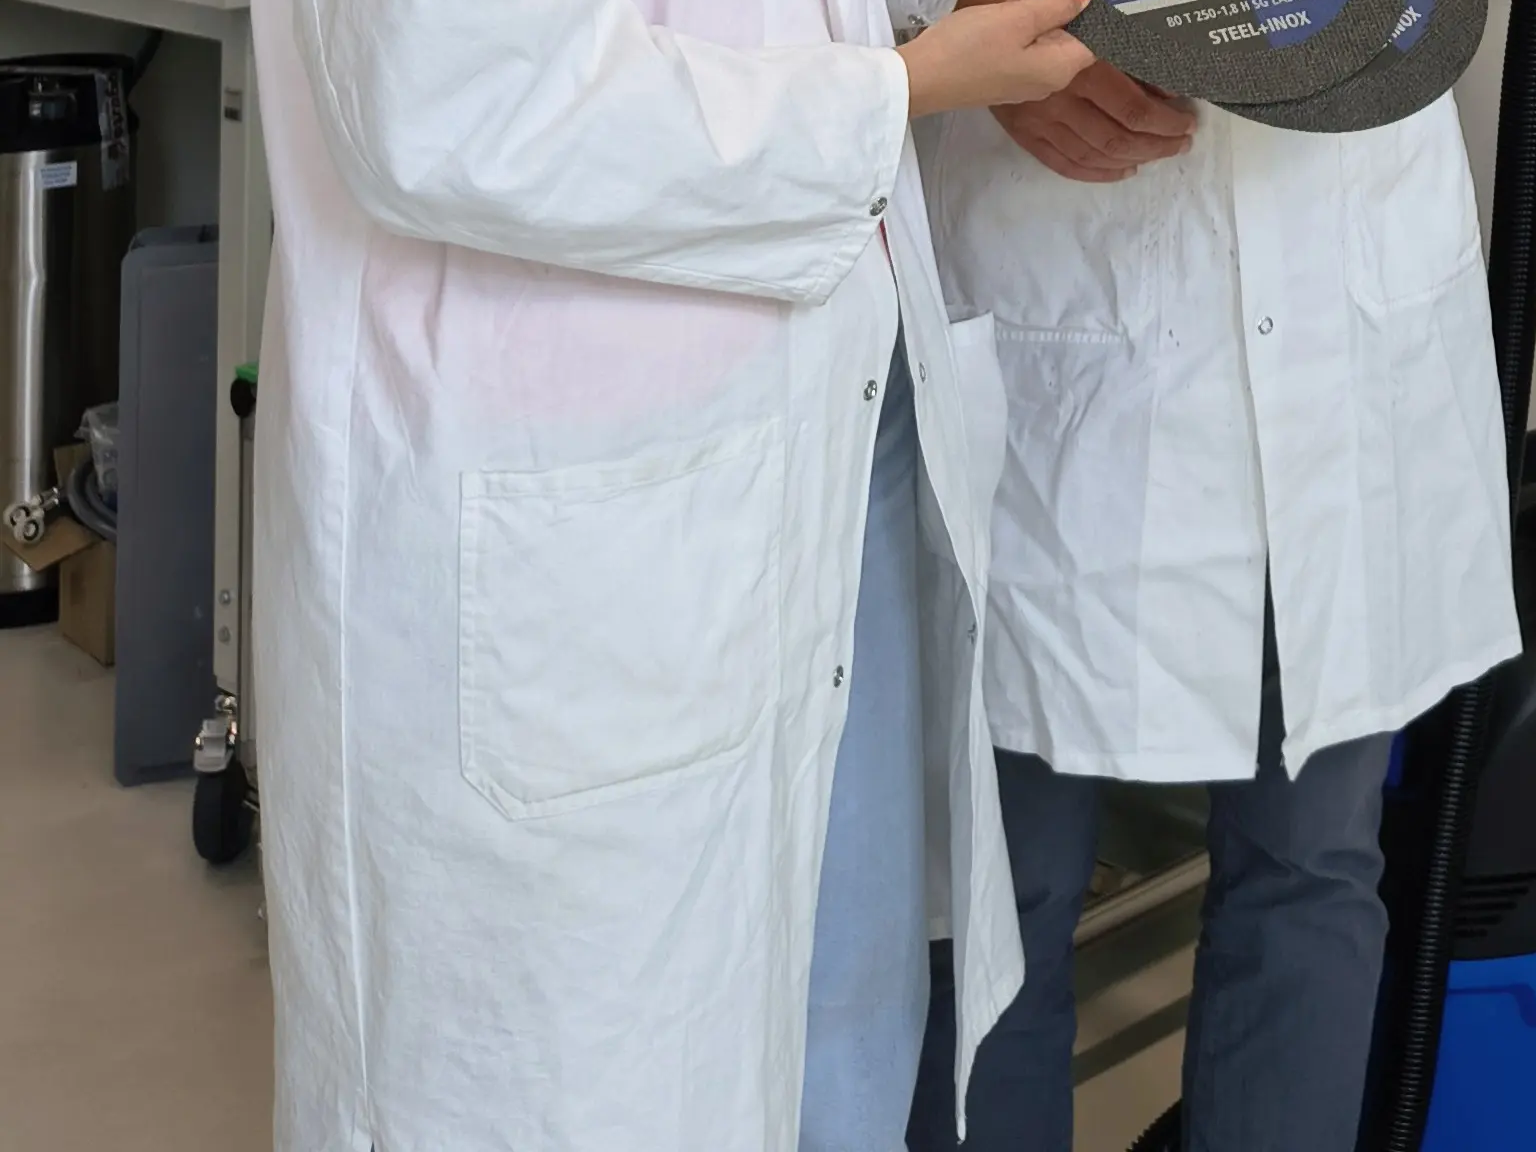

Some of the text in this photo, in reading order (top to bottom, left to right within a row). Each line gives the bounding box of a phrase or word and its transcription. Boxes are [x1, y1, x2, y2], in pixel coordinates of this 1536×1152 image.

[1166, 15, 1183, 28] 80
[1183, 12, 1192, 23] T
[1194, 3, 1239, 22] 250-1,8
[1240, 0, 1251, 12] H
[1208, 10, 1312, 45] STEEL+INOX
